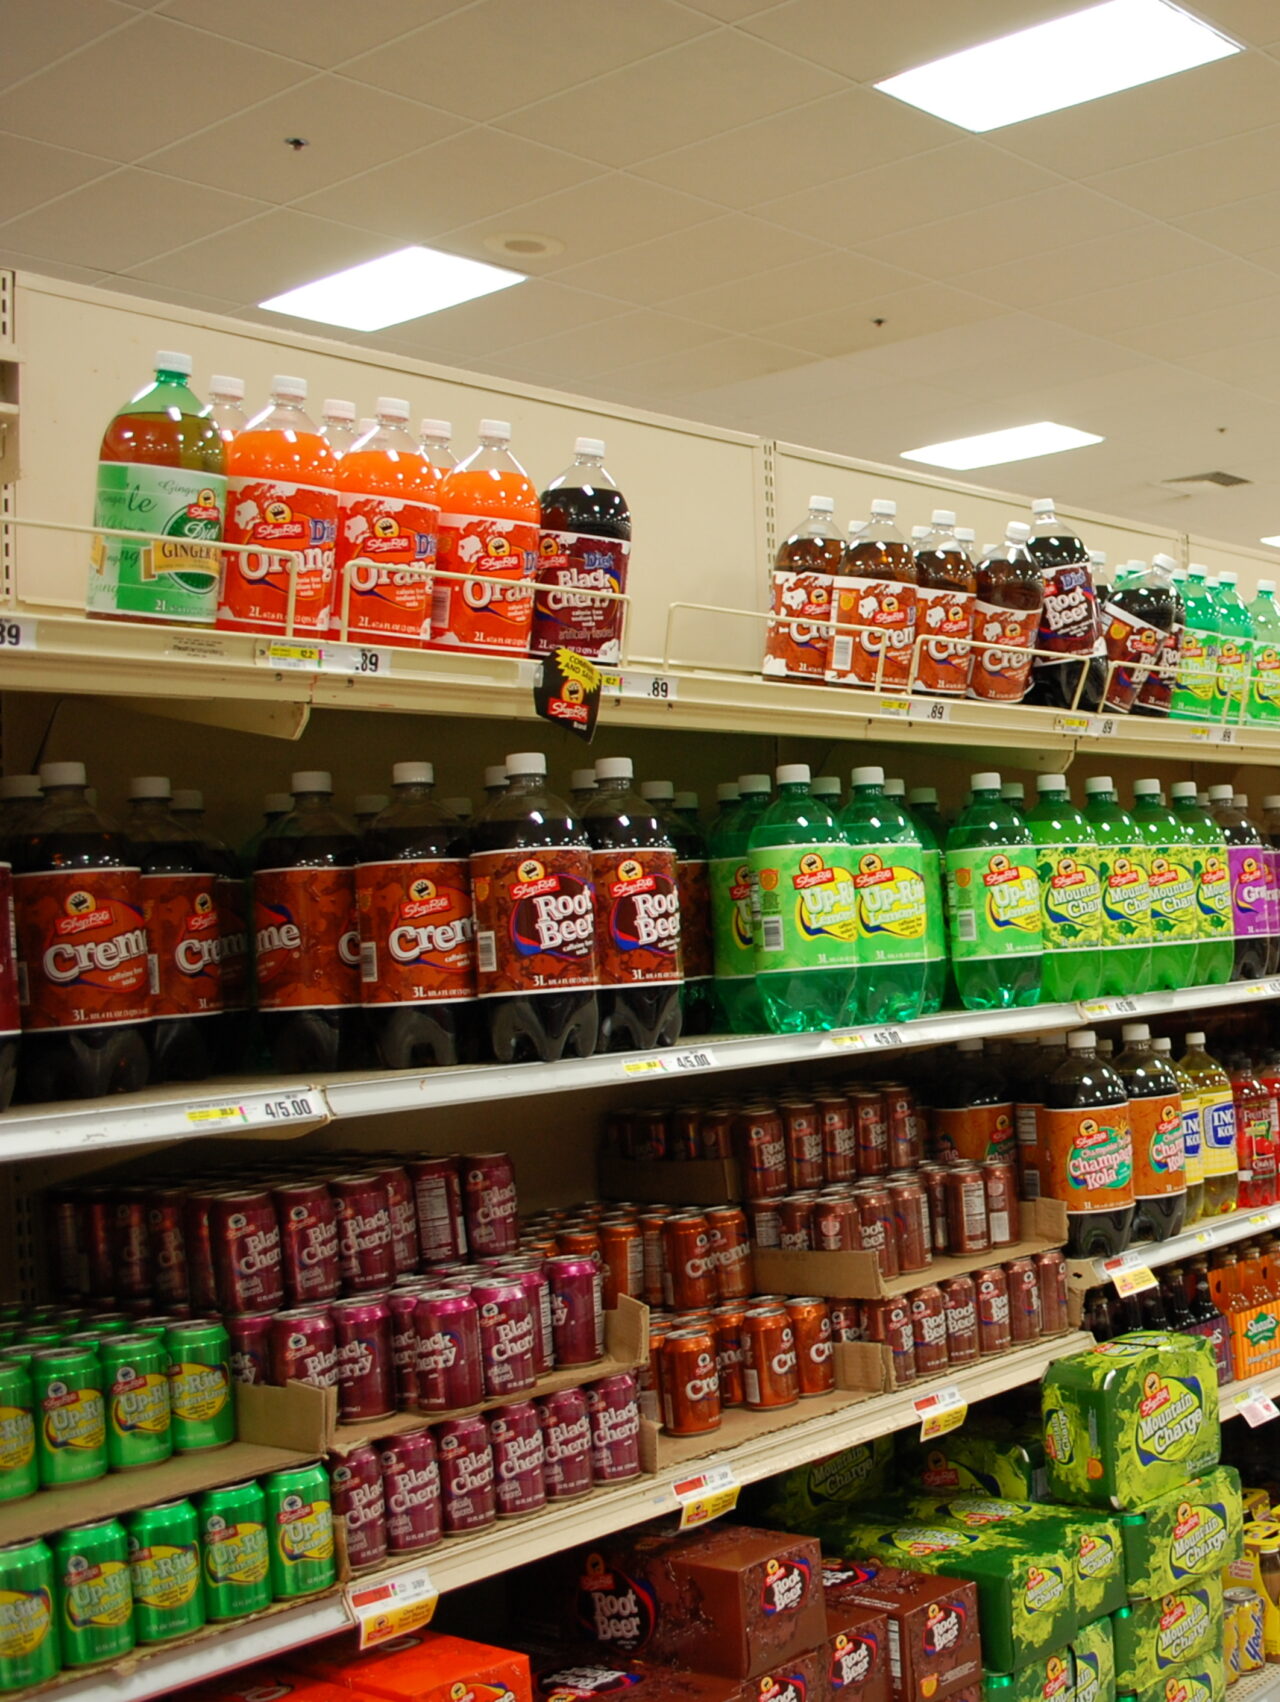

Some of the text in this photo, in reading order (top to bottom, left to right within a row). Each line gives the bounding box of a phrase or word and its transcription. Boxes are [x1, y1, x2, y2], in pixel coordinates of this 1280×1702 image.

[257, 523, 303, 538] ShopRite
[162, 543, 212, 563] GINGER
[366, 538, 408, 551] ShopRite
[239, 543, 336, 583] Orang
[584, 551, 613, 569] Diet
[351, 556, 435, 594] Orang
[558, 568, 611, 587] Black
[1046, 586, 1086, 614] Root
[1049, 603, 1088, 630] Beer
[355, 652, 378, 672] .89
[647, 680, 668, 698] .89
[928, 704, 945, 720] .89
[514, 878, 557, 898] ShopRite
[613, 878, 654, 897] ShopRite
[404, 896, 449, 917] ShopRite
[534, 884, 592, 921] Root
[59, 909, 112, 934] ShopRite
[535, 912, 594, 948] Beer
[389, 918, 475, 961] Crem
[44, 929, 149, 981] Crem
[412, 986, 427, 998] 3L
[533, 975, 545, 986] 3L
[73, 1008, 87, 1021] 3L
[676, 1053, 711, 1069] 4/5.00
[264, 1097, 313, 1121] 4/5.00
[1213, 1108, 1234, 1125] INC
[1069, 1146, 1134, 1175] Champag
[1086, 1168, 1117, 1190] Kola
[598, 1400, 639, 1428] Black
[1140, 1392, 1193, 1443] Mountain
[1153, 1408, 1203, 1455] Charge
[826, 1457, 874, 1495] Charge
[1175, 1516, 1218, 1557] Mountain
[1186, 1528, 1227, 1568] Charge
[773, 1567, 801, 1596] Root
[592, 1589, 638, 1617] Root
[774, 1584, 804, 1612] Beer
[597, 1616, 641, 1641] Beer
[932, 1610, 958, 1634] Root
[1161, 1604, 1207, 1646] Mountain
[1171, 1614, 1210, 1657] Charge
[933, 1623, 959, 1651] Beer
[841, 1642, 868, 1669] Root
[842, 1656, 870, 1684] Beer
